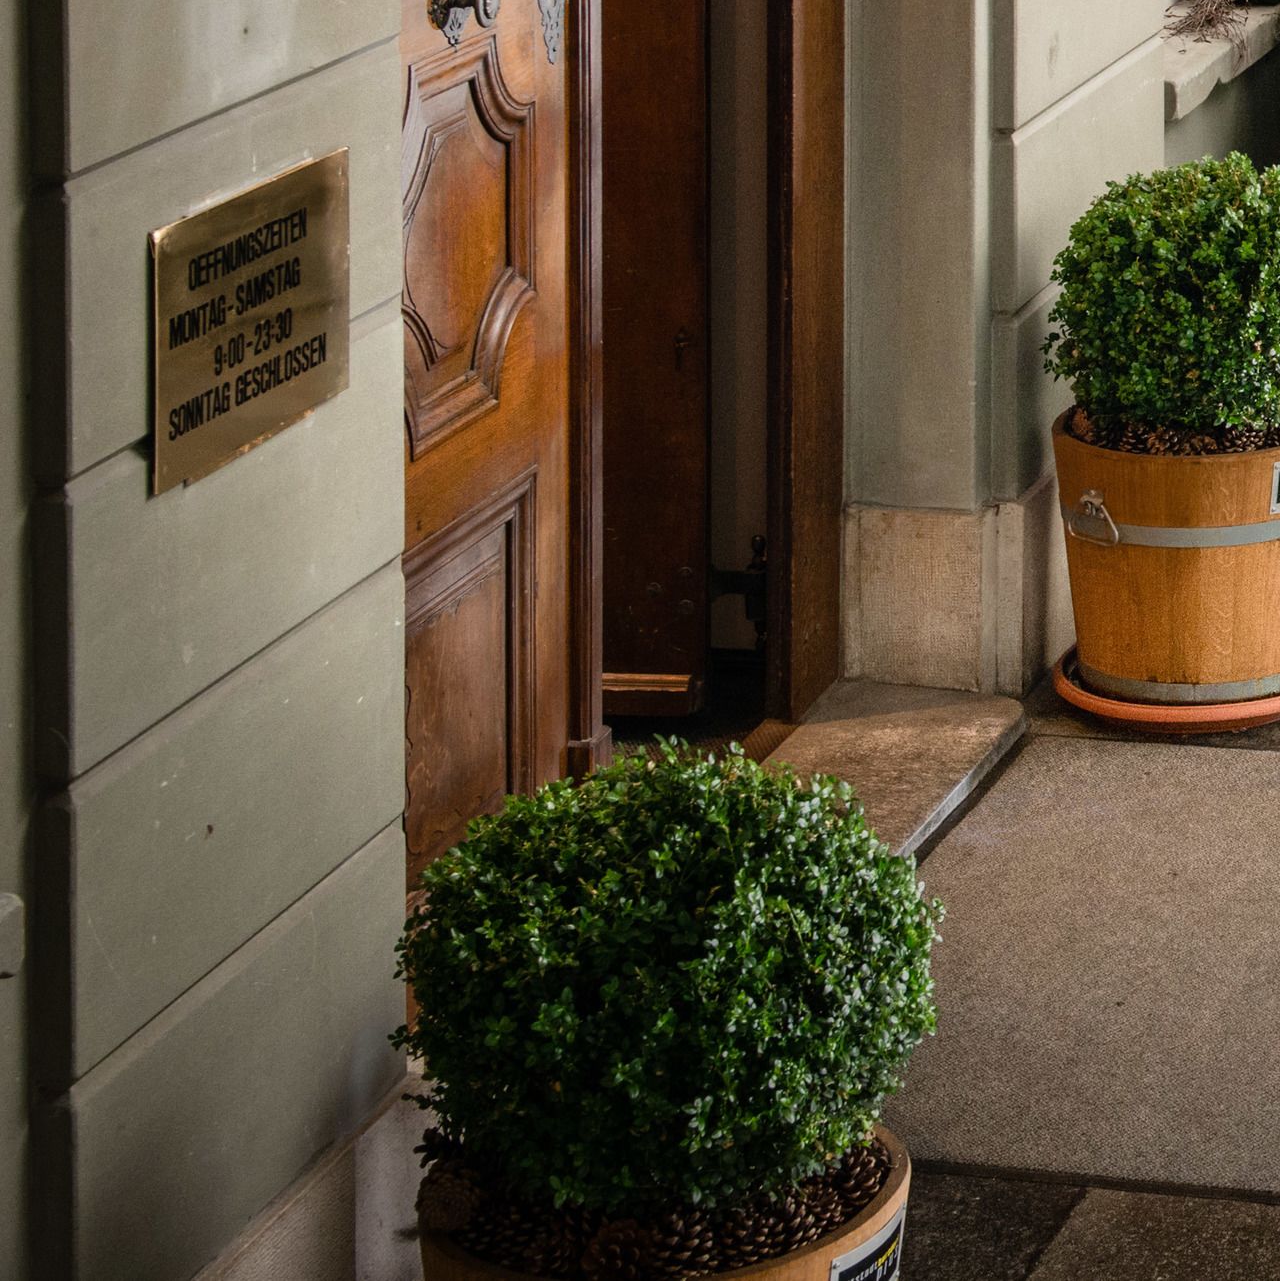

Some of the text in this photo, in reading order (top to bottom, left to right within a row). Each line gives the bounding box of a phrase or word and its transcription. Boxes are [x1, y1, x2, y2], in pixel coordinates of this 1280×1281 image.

[188, 206, 307, 292] OEFFNUNGSZEITEN
[168, 332, 327, 441] SONNTAG GESCHLOSSEN
